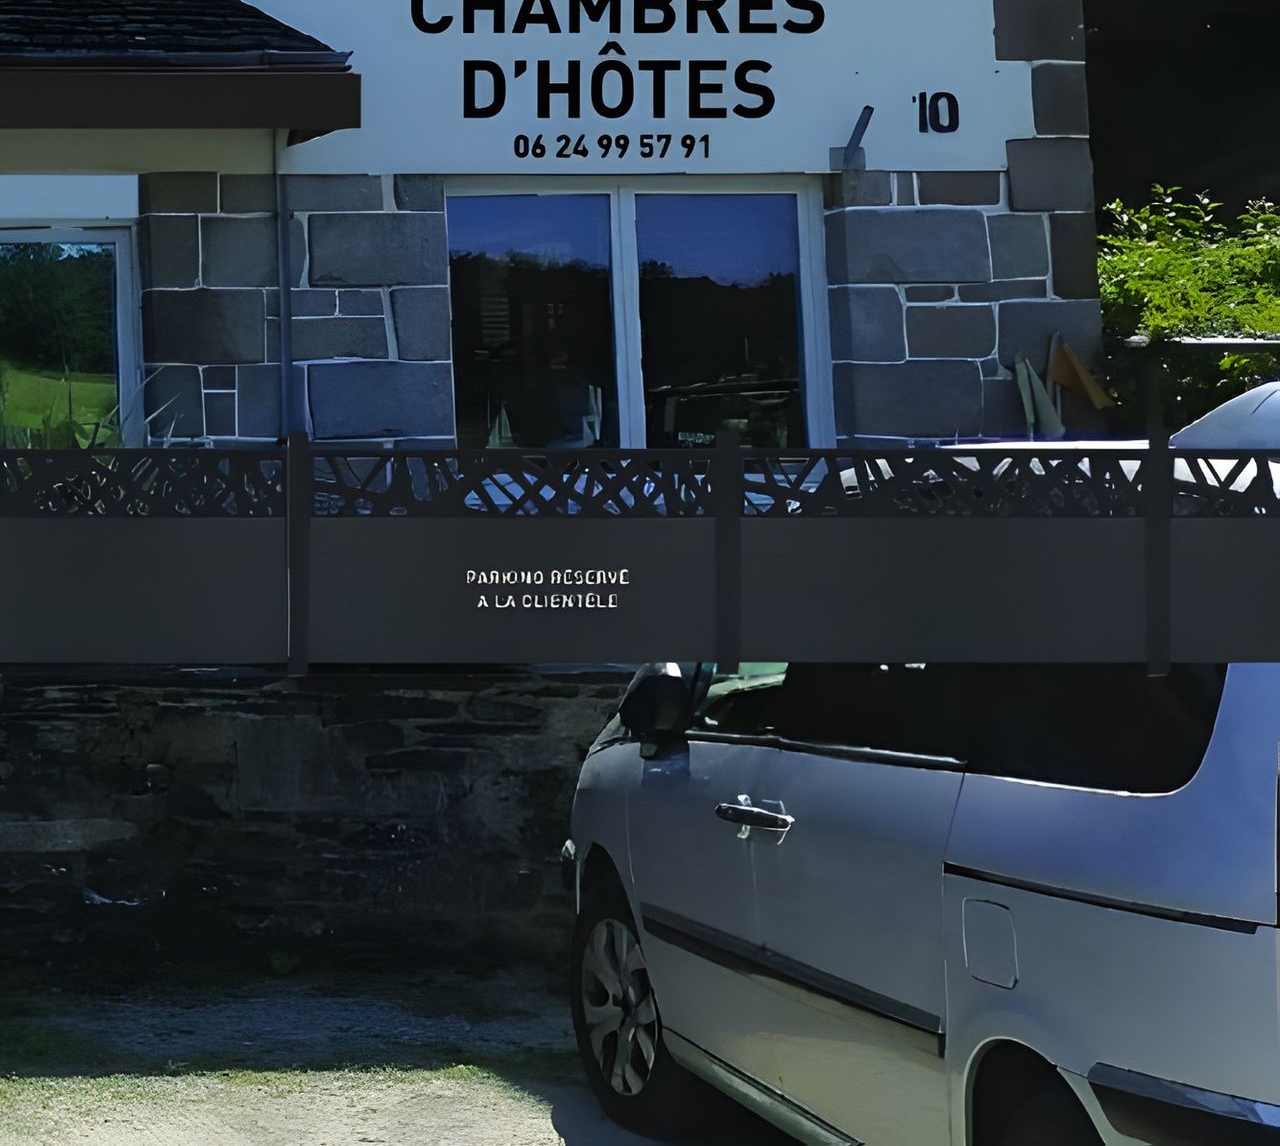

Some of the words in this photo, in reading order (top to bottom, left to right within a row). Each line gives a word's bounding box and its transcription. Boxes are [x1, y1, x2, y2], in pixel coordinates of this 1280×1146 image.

[462, 41, 775, 119] D'HÔTES
[912, 91, 960, 133] 10
[514, 134, 546, 159] 06
[555, 134, 589, 159] 24
[597, 134, 630, 159] 99
[639, 134, 673, 159] 57
[681, 134, 711, 159] 91
[494, 594, 516, 608] LA
